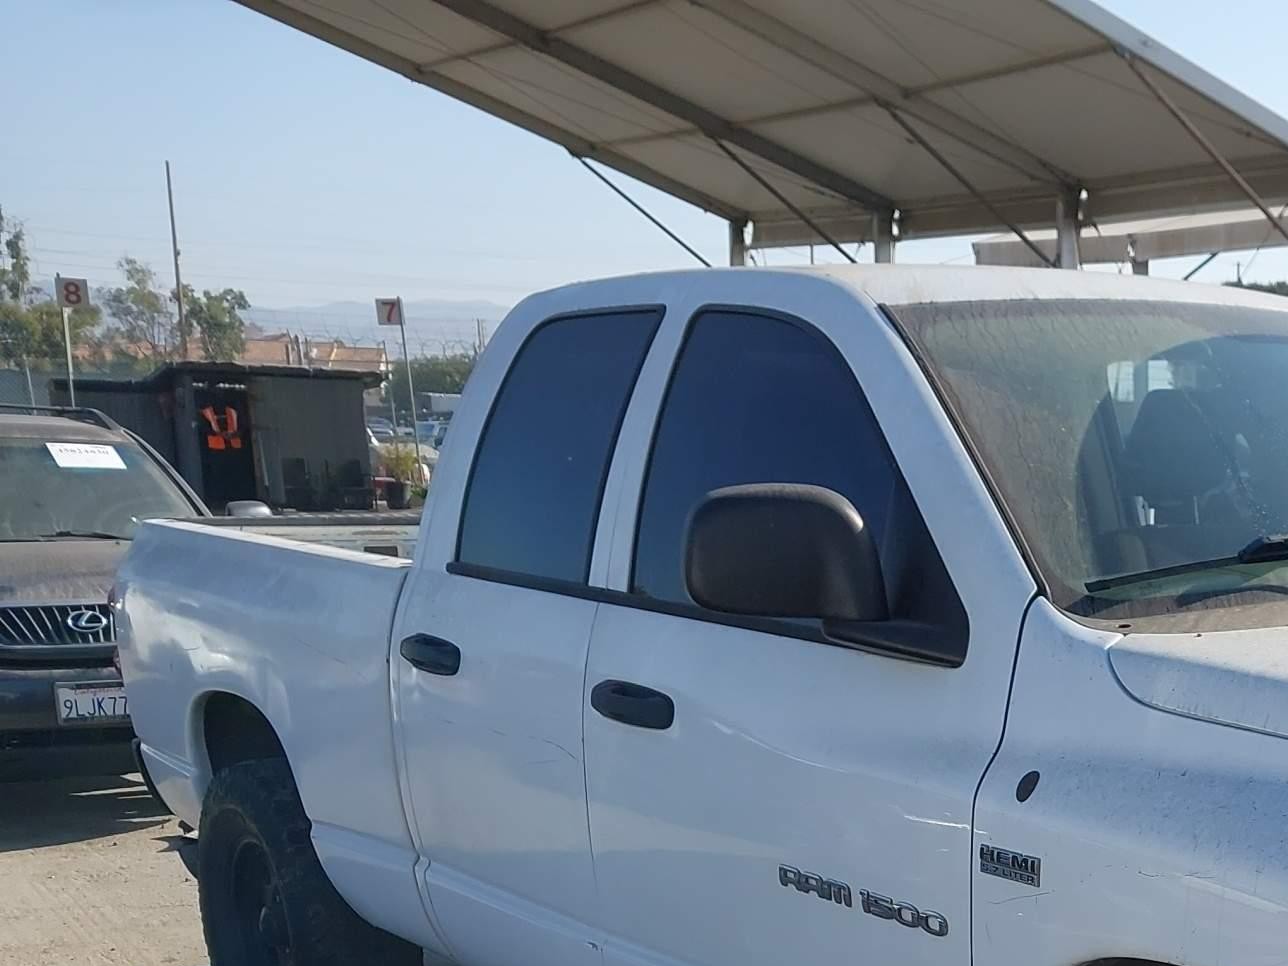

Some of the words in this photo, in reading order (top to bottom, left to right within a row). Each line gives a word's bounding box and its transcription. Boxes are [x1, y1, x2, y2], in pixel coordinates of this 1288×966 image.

[64, 282, 82, 305] 8
[381, 301, 397, 322] 7
[63, 695, 128, 718] 9LJK77
[980, 845, 1038, 874] HEMI
[1002, 868, 1036, 884] LITER
[778, 863, 853, 908] RAM
[859, 888, 949, 937] 1500
